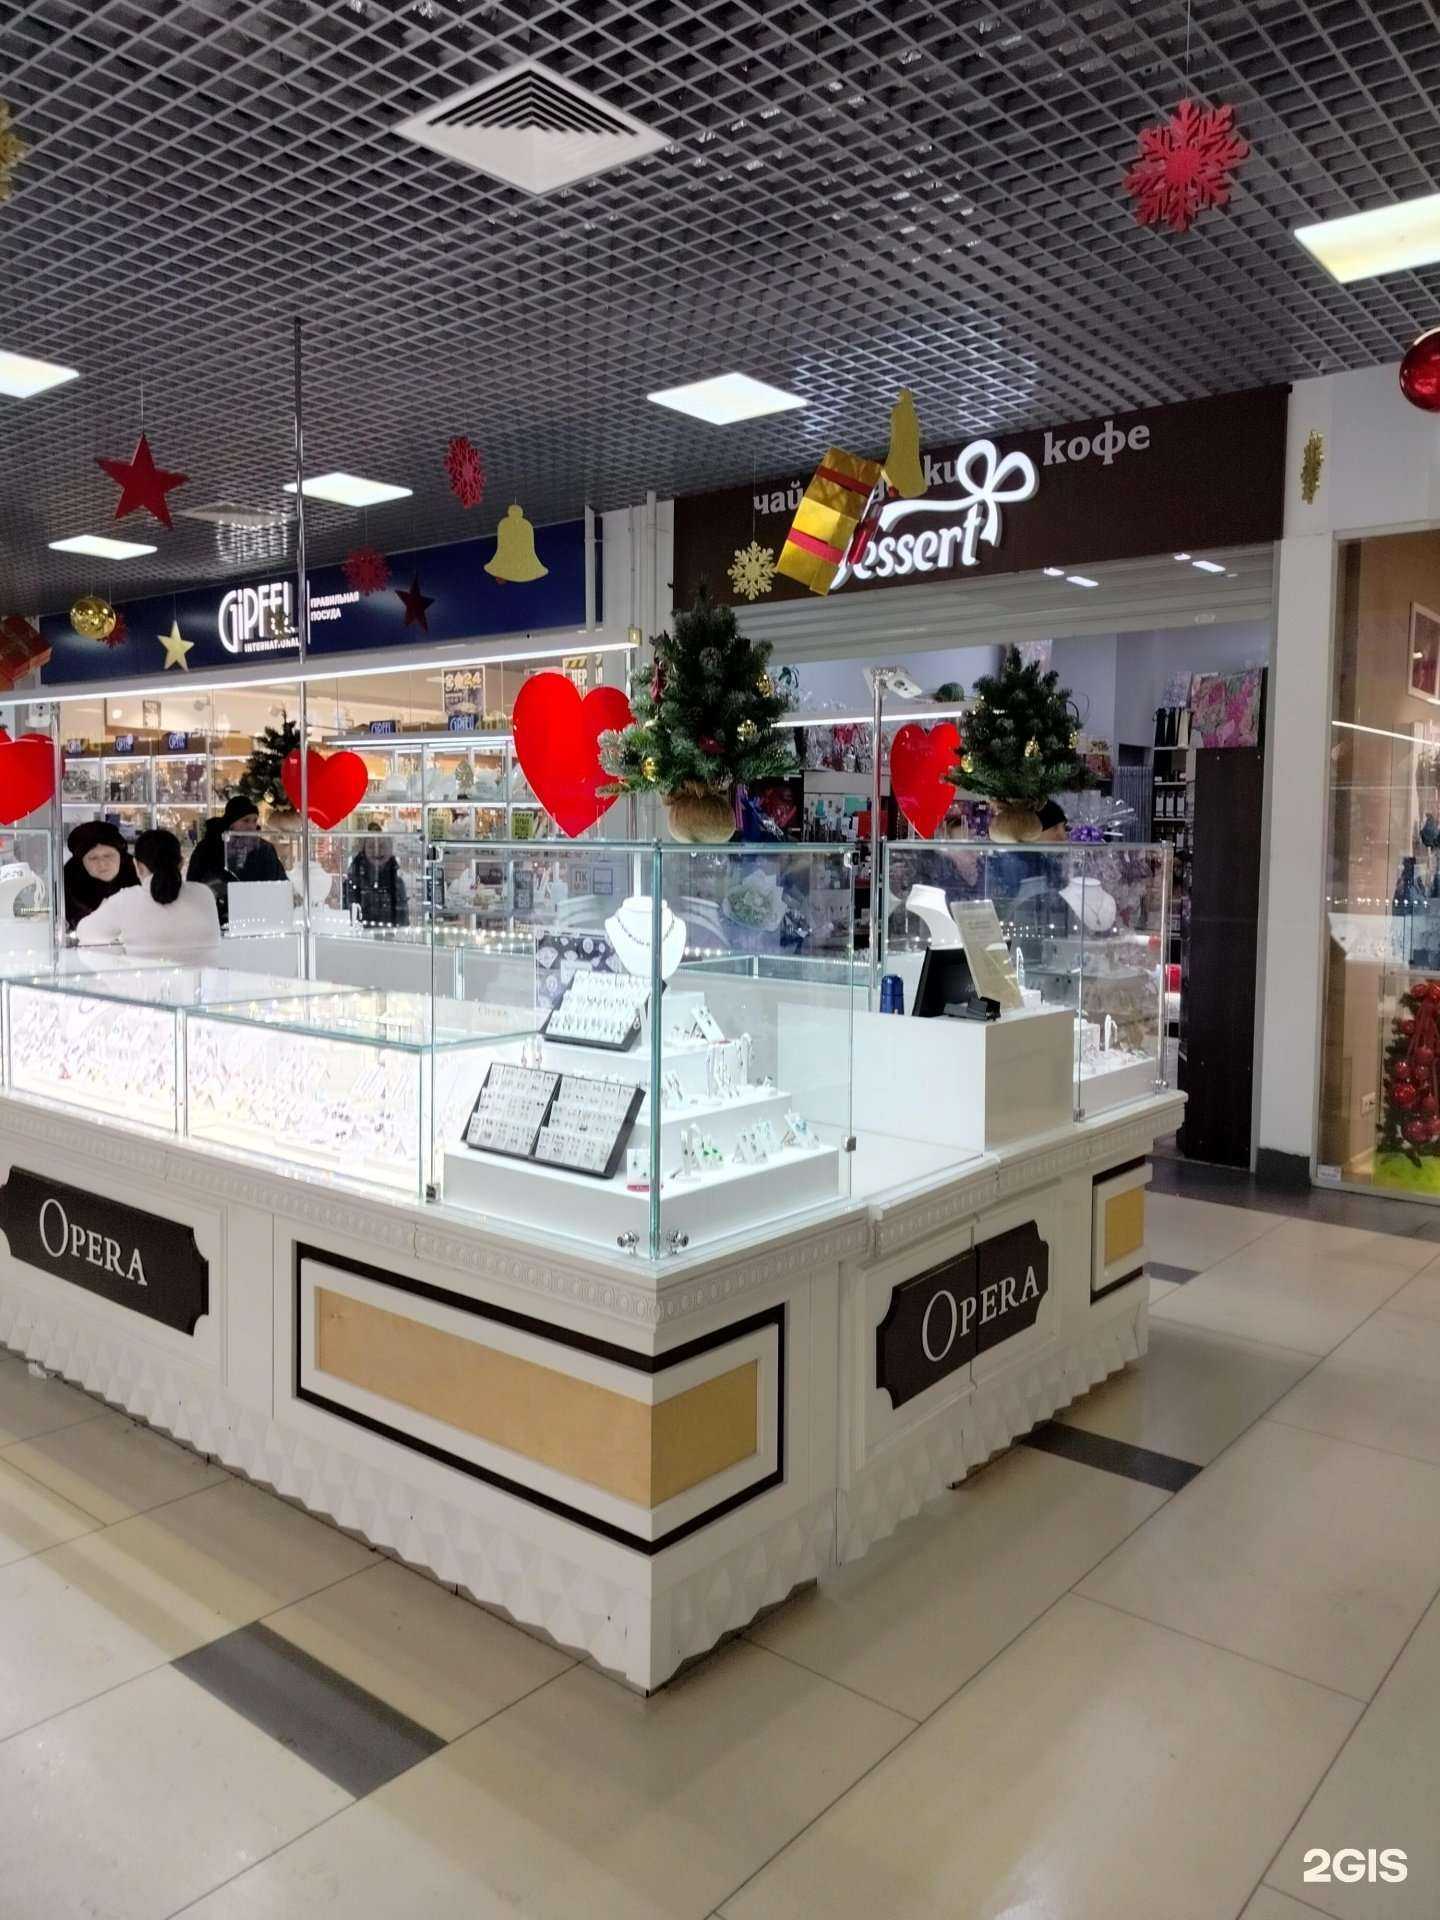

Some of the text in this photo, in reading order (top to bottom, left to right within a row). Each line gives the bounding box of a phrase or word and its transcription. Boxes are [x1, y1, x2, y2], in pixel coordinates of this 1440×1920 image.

[1042, 420, 1151, 466] кофе
[753, 480, 804, 515] чай
[830, 503, 983, 590] essert
[310, 591, 360, 609] ПРАВИЛЬНАЯ
[310, 607, 342, 621] ПОСУДА
[39, 1198, 148, 1287] OPERA
[922, 1265, 1040, 1363] OPERA
